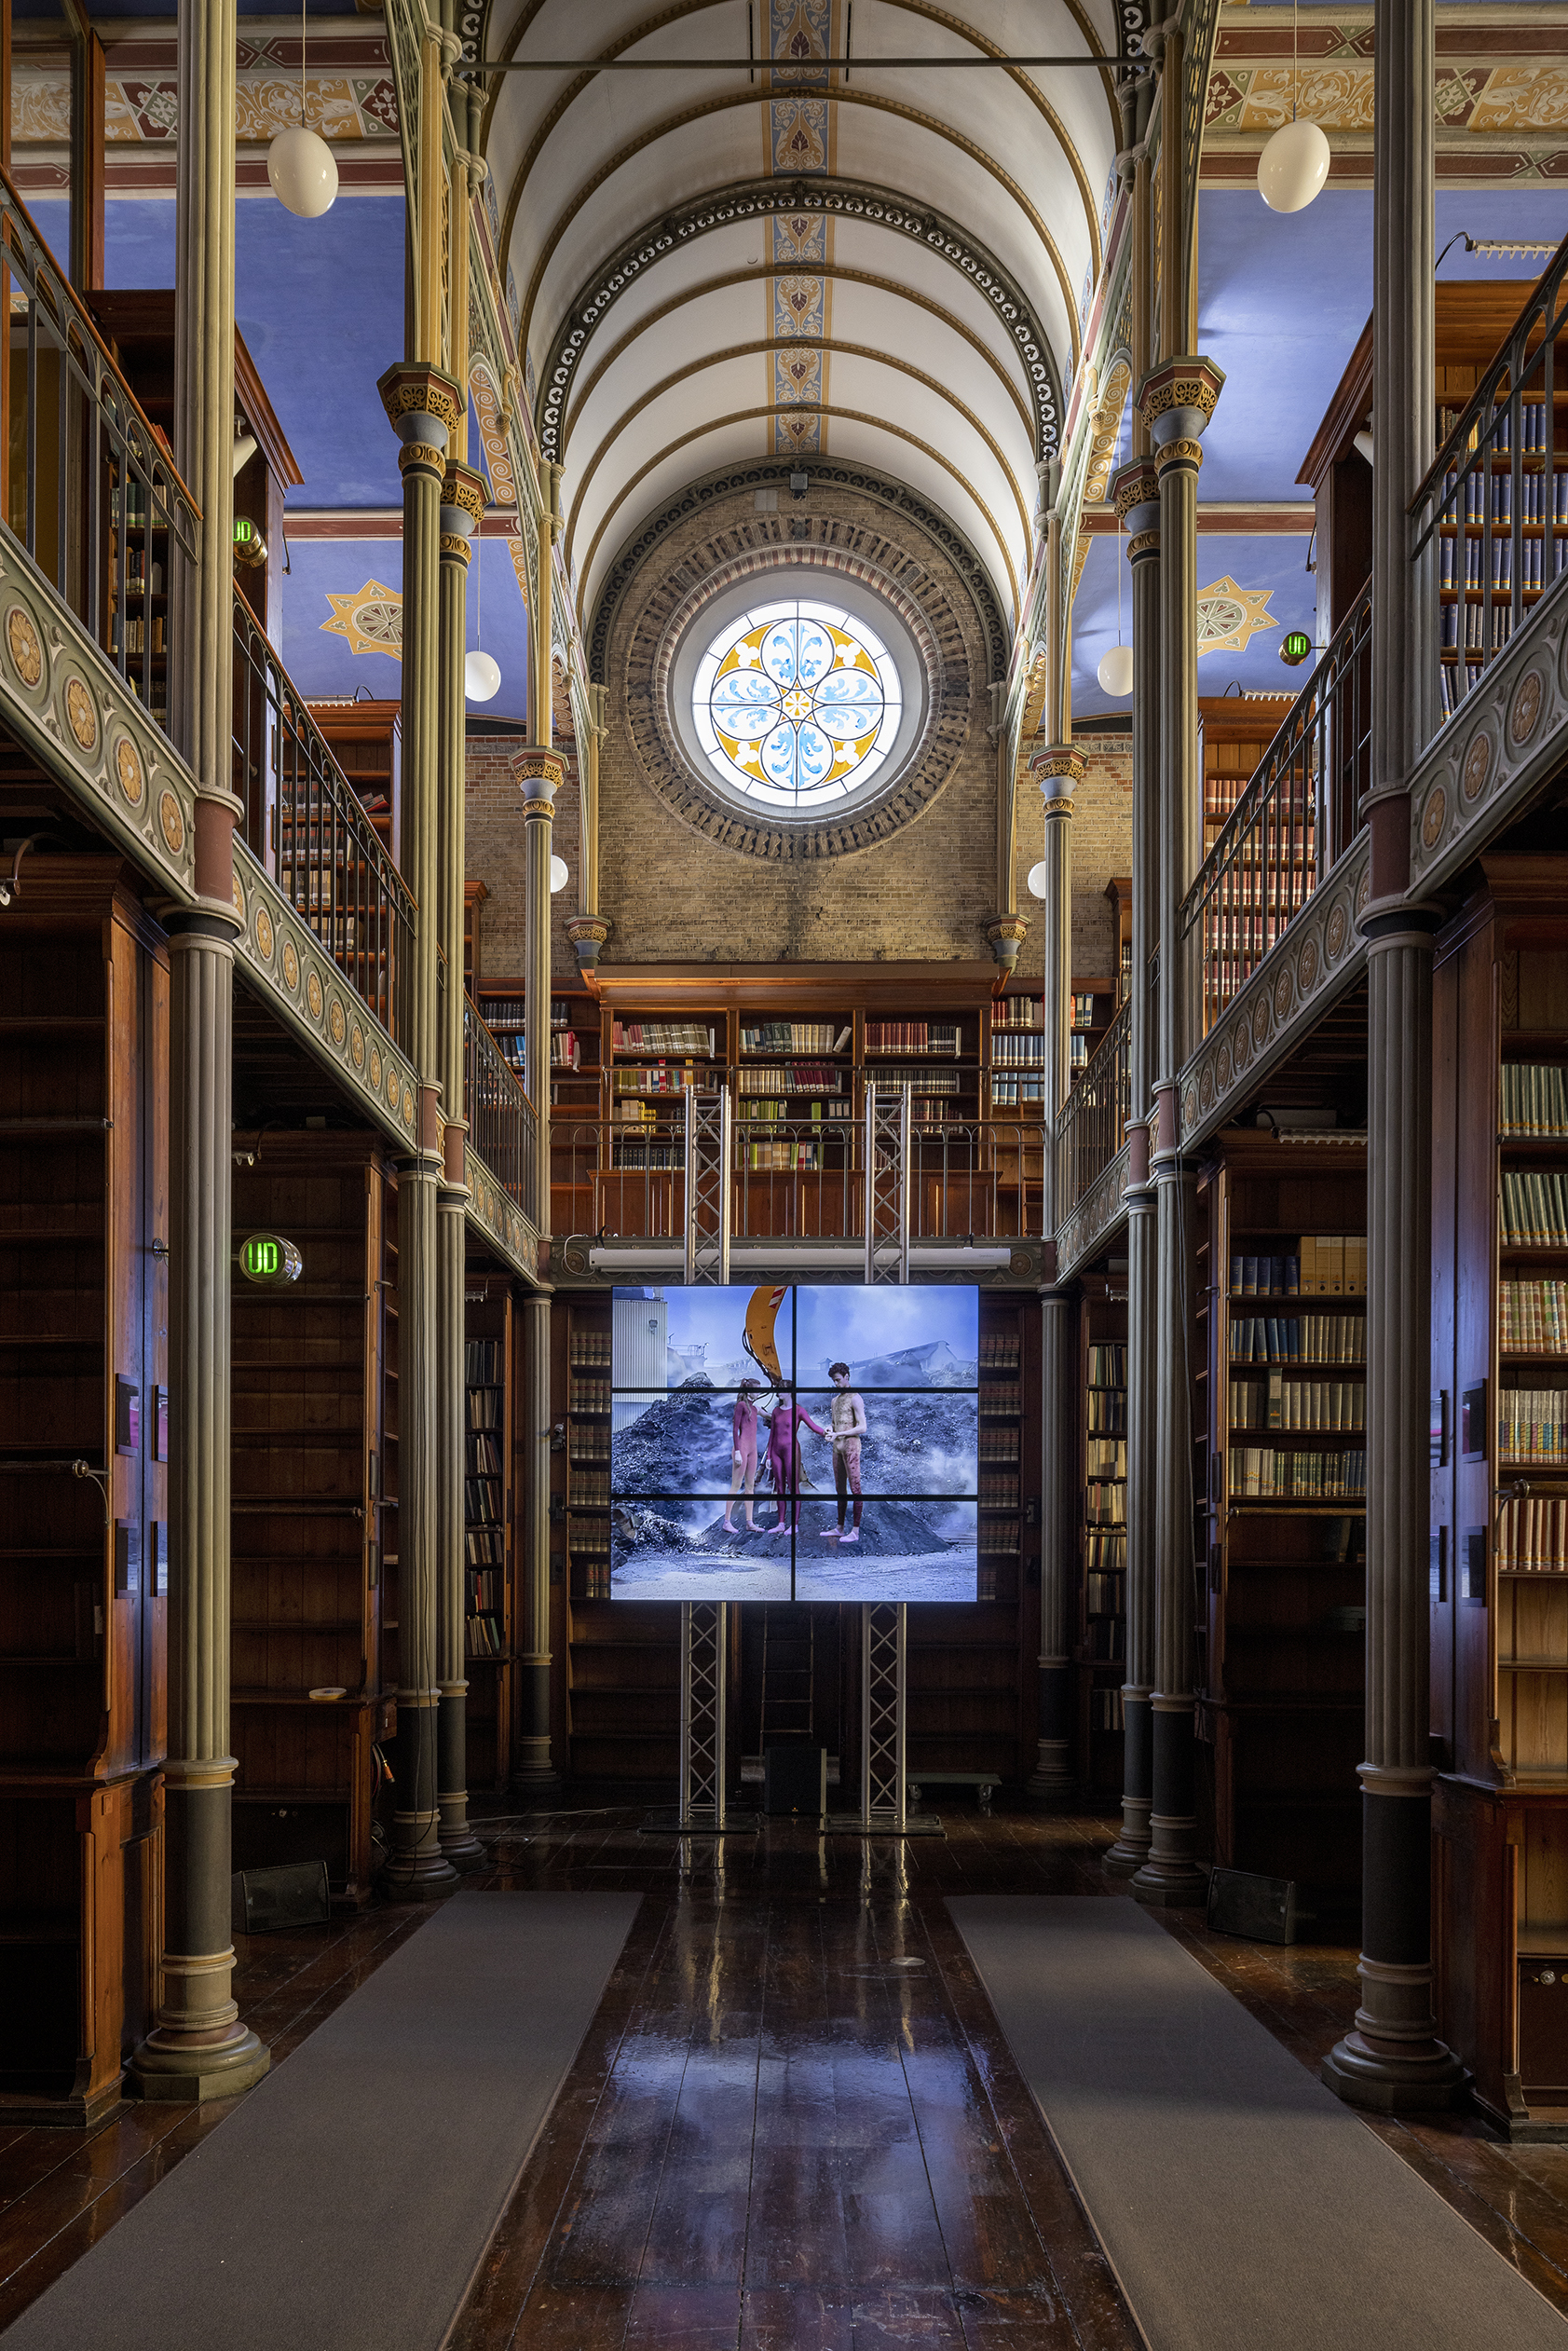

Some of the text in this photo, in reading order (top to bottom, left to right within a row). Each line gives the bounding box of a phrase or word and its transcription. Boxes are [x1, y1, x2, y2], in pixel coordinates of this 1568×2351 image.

[233, 521, 251, 542] UD
[1288, 636, 1306, 654] UD
[248, 1242, 278, 1274] UD
